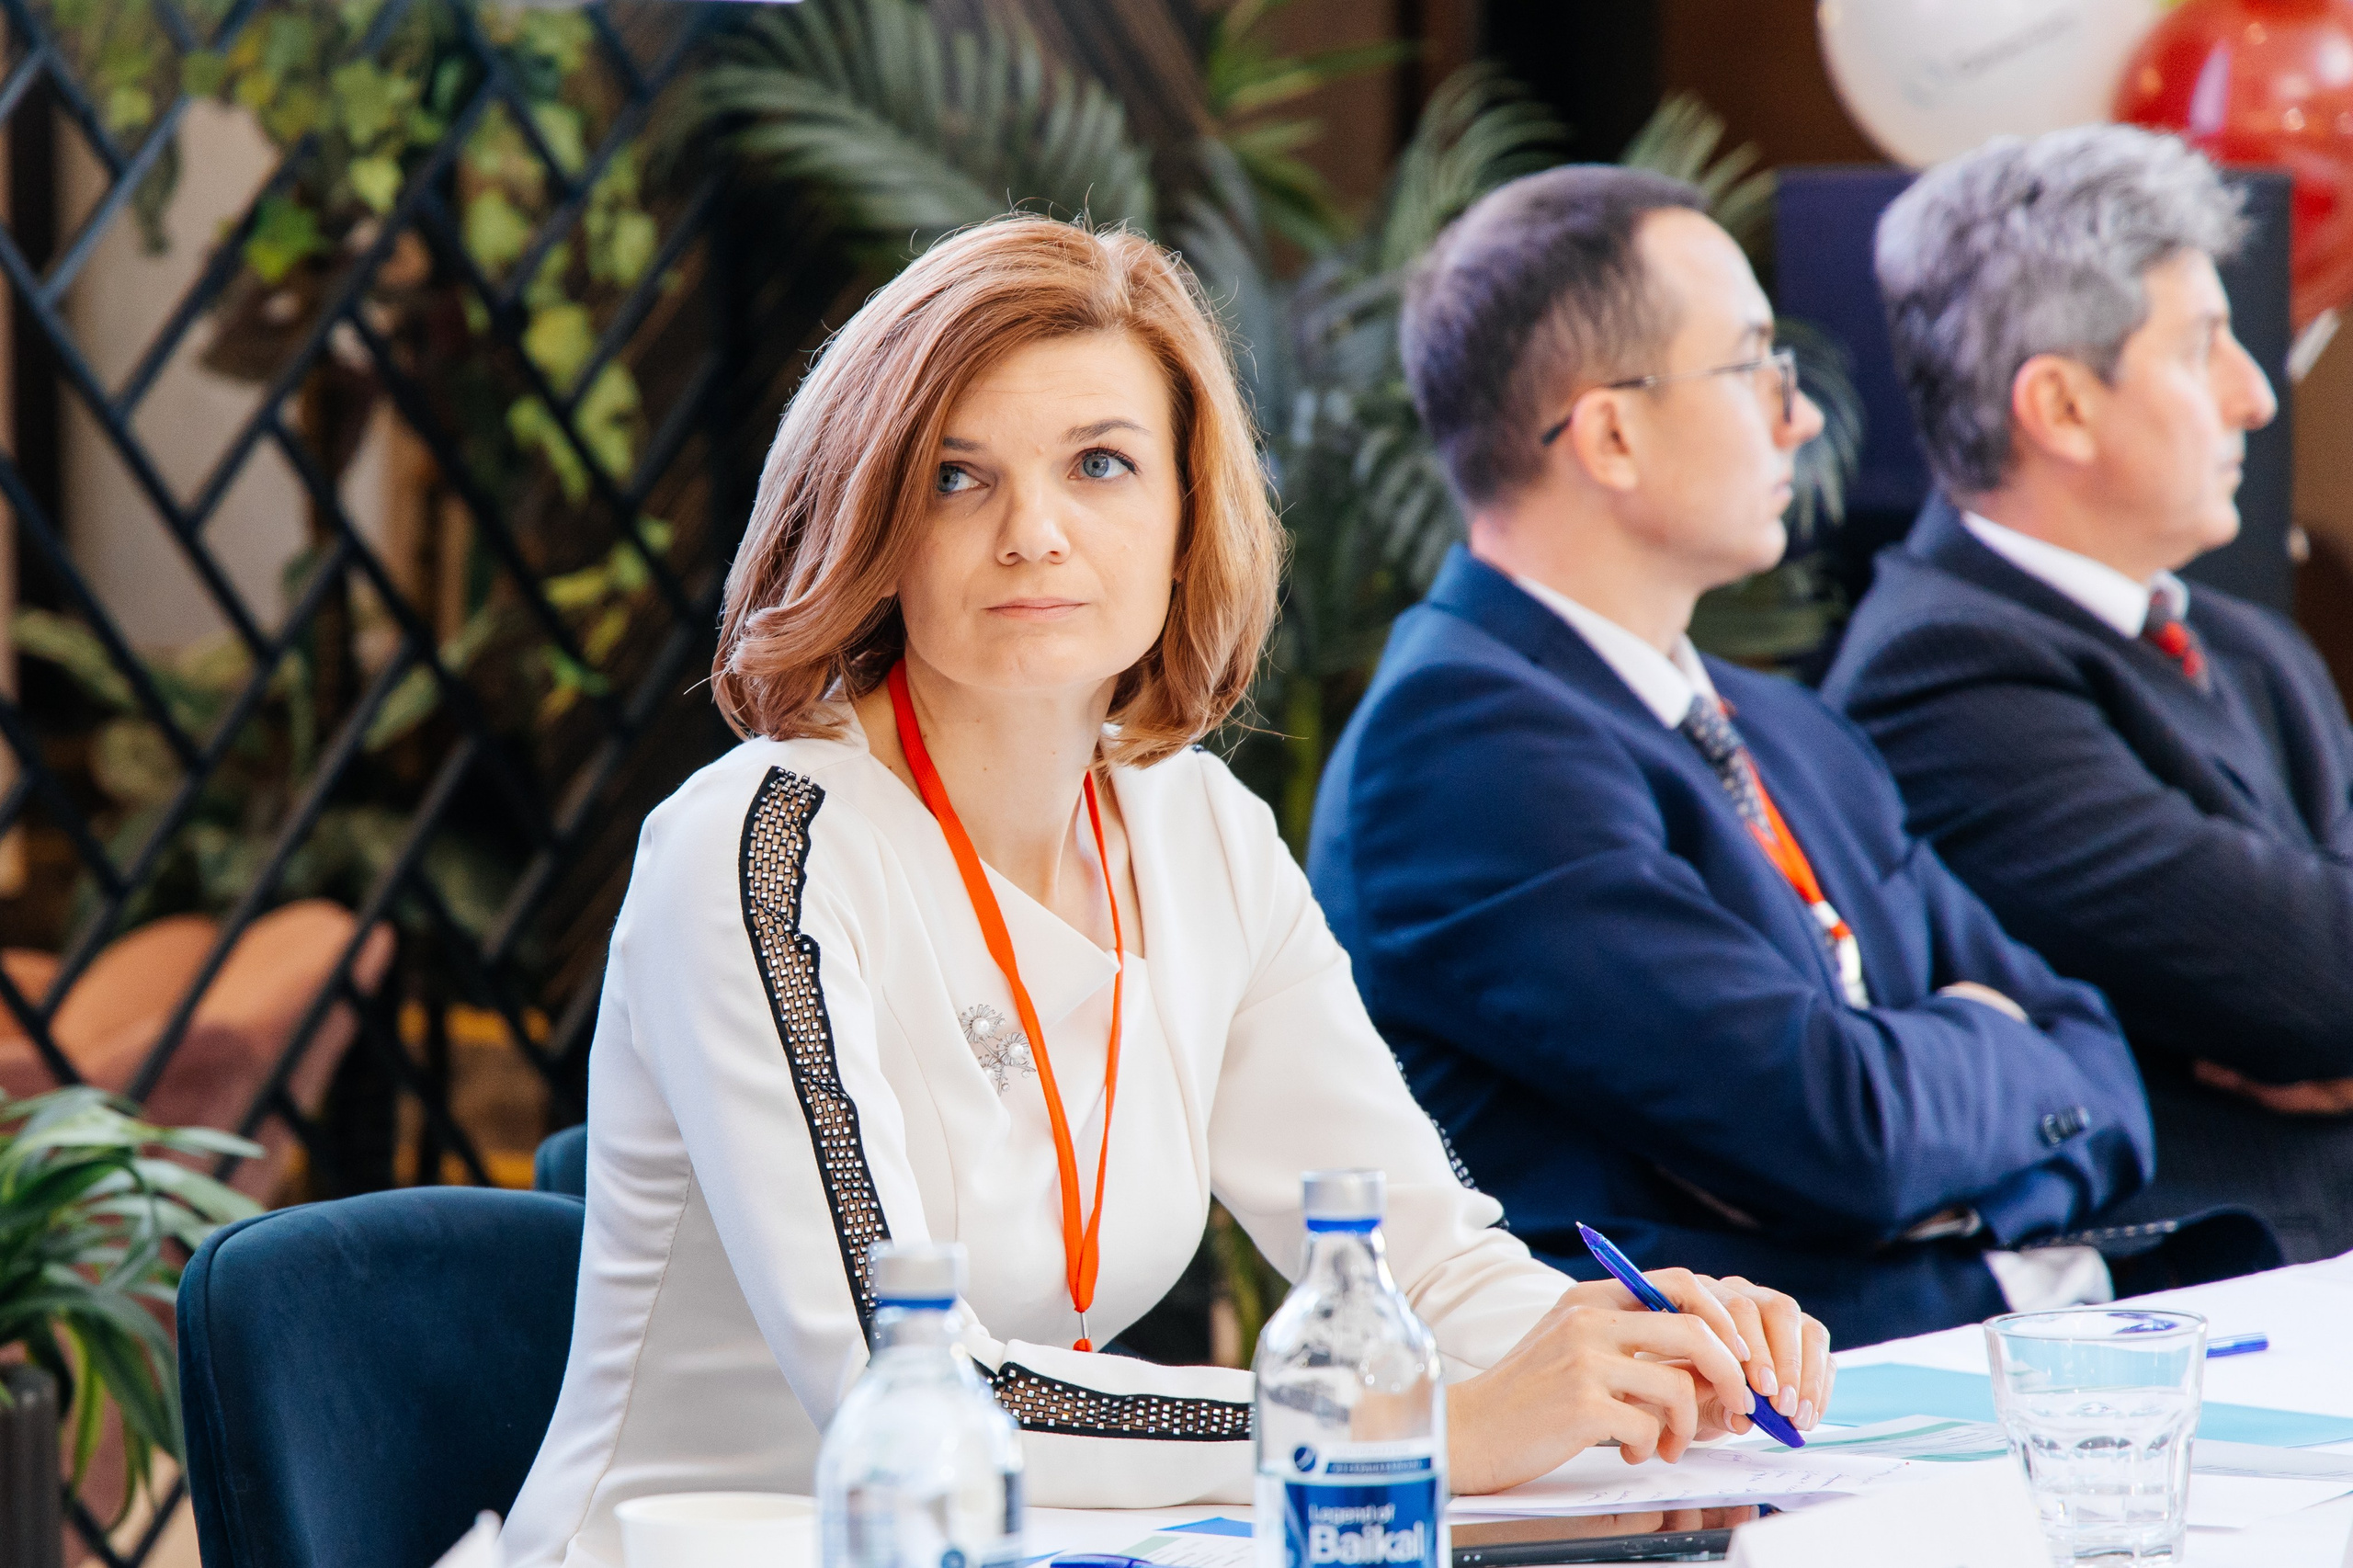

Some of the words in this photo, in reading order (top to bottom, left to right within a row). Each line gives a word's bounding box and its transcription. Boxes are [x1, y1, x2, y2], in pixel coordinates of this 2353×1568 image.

[1309, 1503, 1377, 1526] Legend
[1377, 1502, 1395, 1523] of
[1309, 1520, 1424, 1565] Baikal
